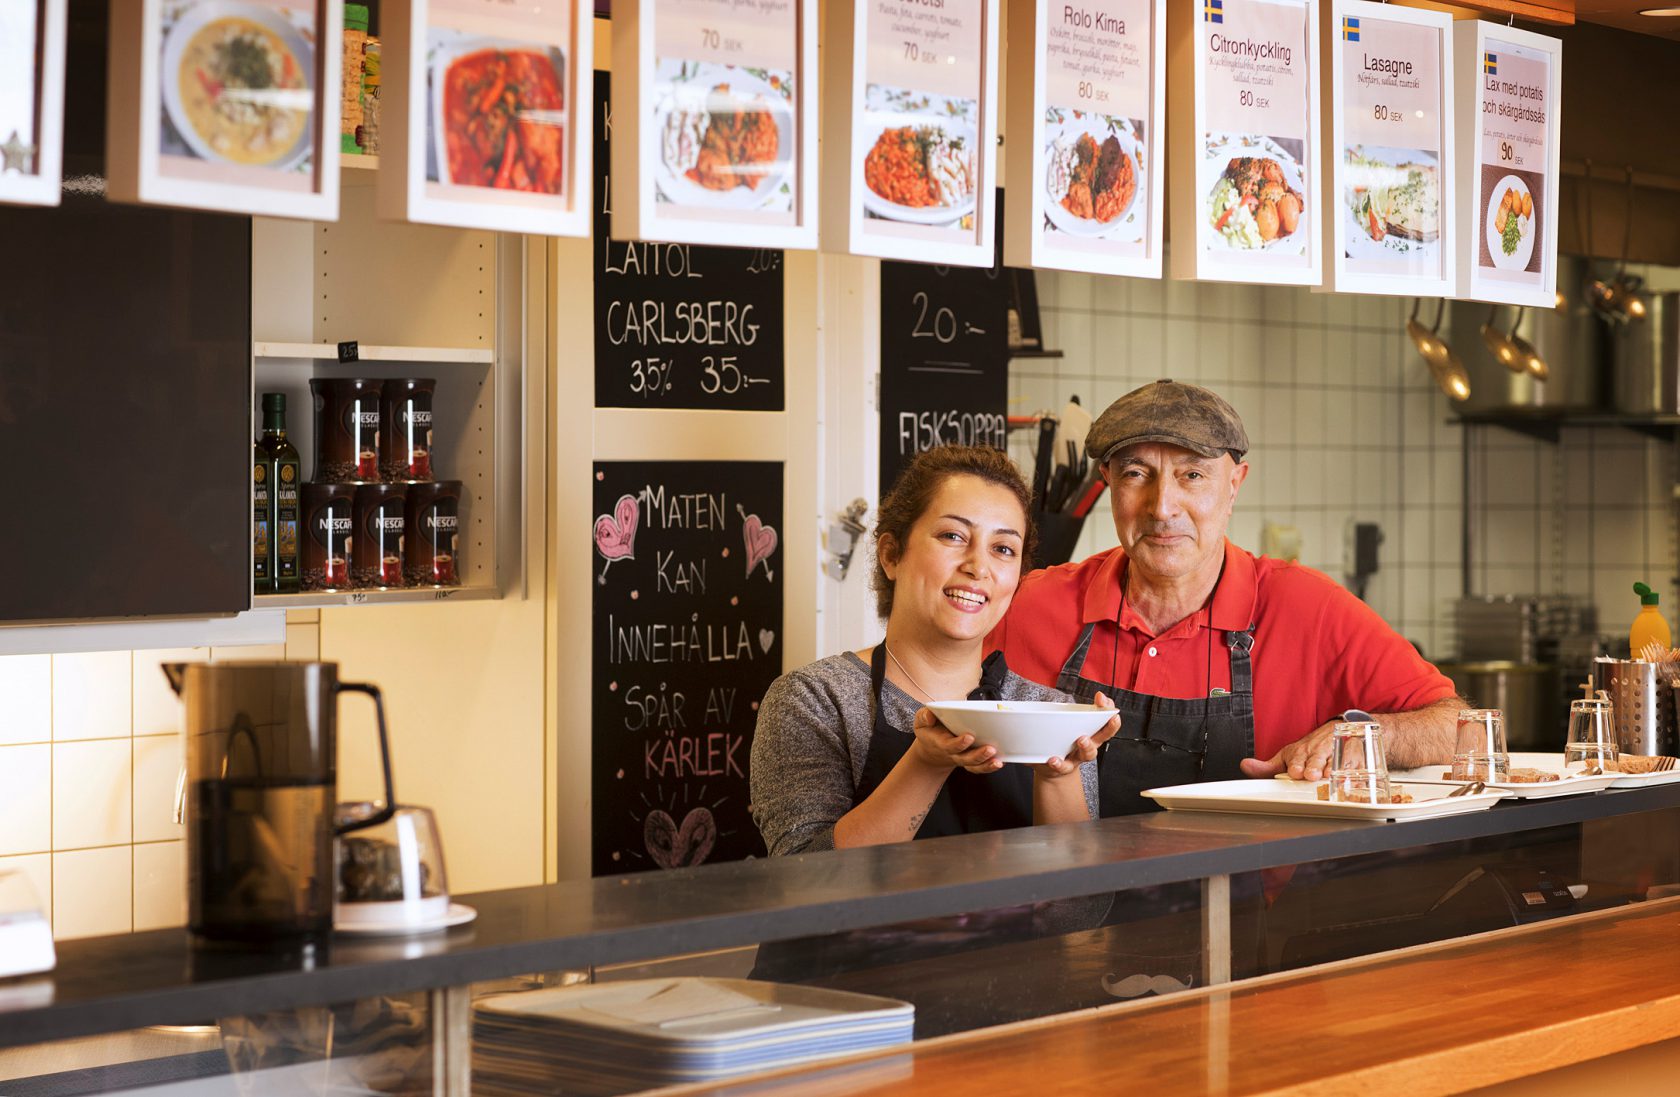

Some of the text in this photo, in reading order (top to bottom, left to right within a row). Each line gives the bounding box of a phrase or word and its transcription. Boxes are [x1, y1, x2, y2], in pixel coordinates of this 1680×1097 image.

[1064, 5, 1126, 35] Rolo Kima
[702, 28, 720, 49] 70
[903, 41, 938, 64] 70 SEK
[1210, 33, 1291, 66] Citronkyckling
[1364, 52, 1413, 78] Lasagne
[1078, 81, 1110, 101] 80 SEK
[1240, 90, 1269, 108] 80 SEK
[1485, 75, 1543, 101] Lax med potatis
[1374, 104, 1403, 122] 80 SEK
[1482, 99, 1545, 123] och skärgårdssås
[1502, 141, 1523, 165] 90 SEK
[607, 300, 760, 345] CARLSBERG
[899, 410, 1006, 455] FISKSOPPA
[645, 484, 725, 531] MATEN
[656, 550, 706, 594] KAN
[609, 612, 753, 664] INNEHÅLLA
[624, 681, 737, 731] SPÅR AV
[645, 729, 745, 779] KÄRLEK
